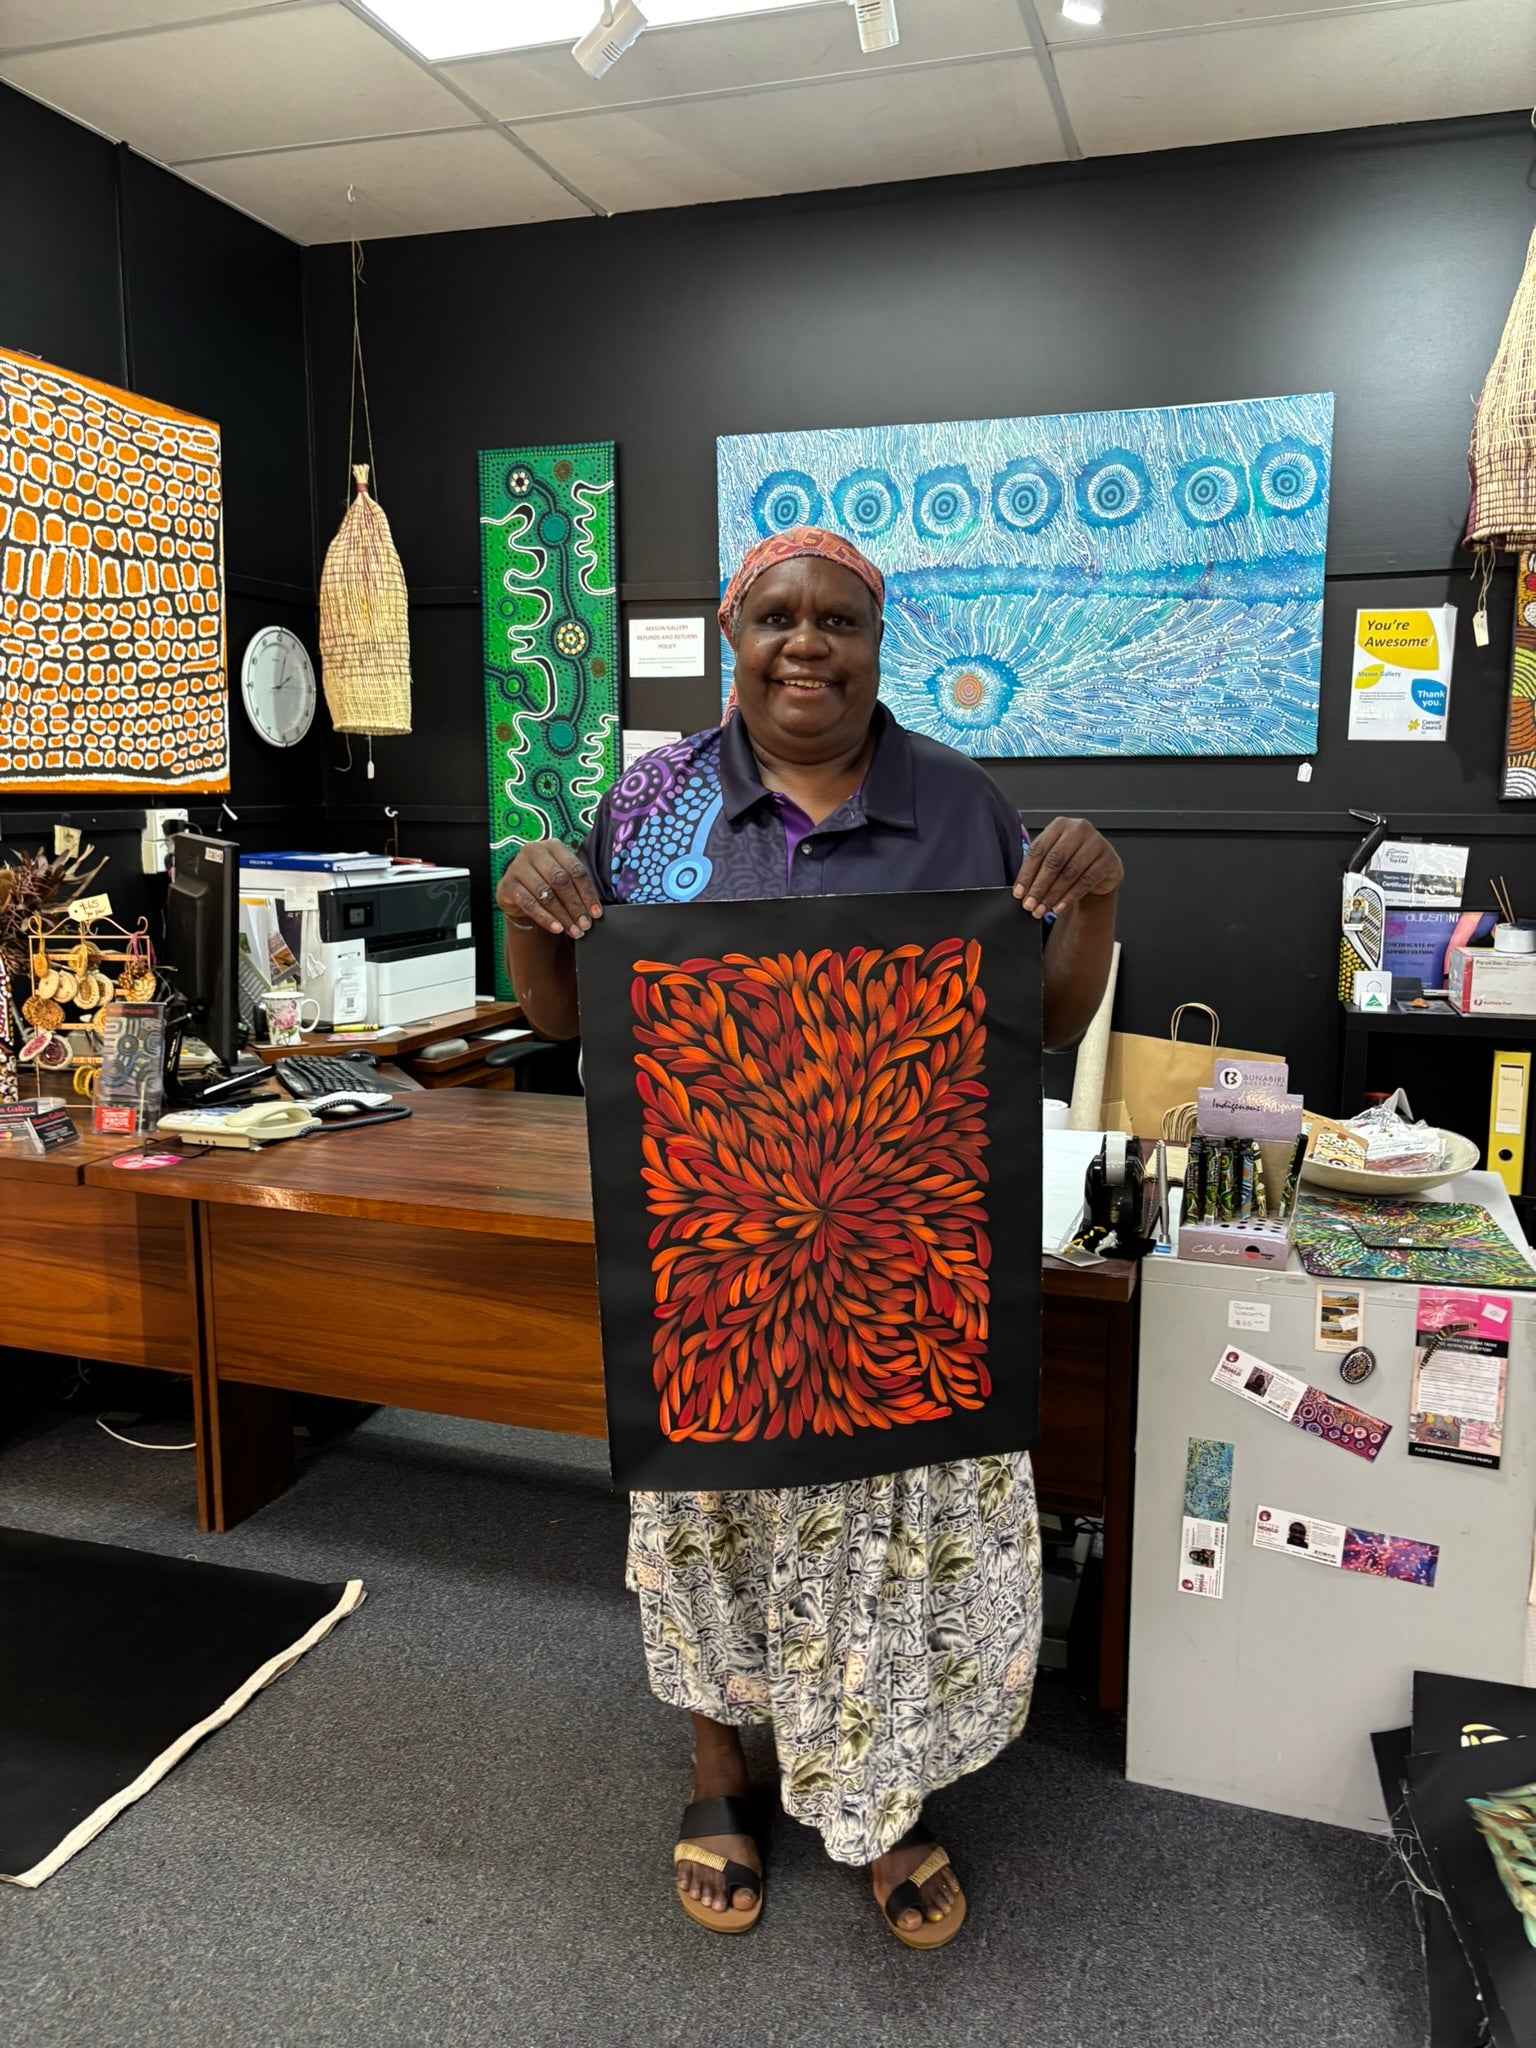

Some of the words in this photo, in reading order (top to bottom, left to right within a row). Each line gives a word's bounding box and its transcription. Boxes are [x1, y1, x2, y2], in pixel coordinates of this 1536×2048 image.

[1364, 635, 1434, 647] Awesome!
[1417, 690, 1446, 699] Thank
[1422, 699, 1442, 708] you.
[1382, 881, 1410, 889] Certificate
[1243, 1074, 1286, 1084] BUNABIRI
[1212, 1098, 1261, 1114] Indigenous
[1221, 1364, 1242, 1377] WORLD
[1477, 1456, 1493, 1464] PEOPLE
[1257, 1525, 1279, 1534] WORLD
